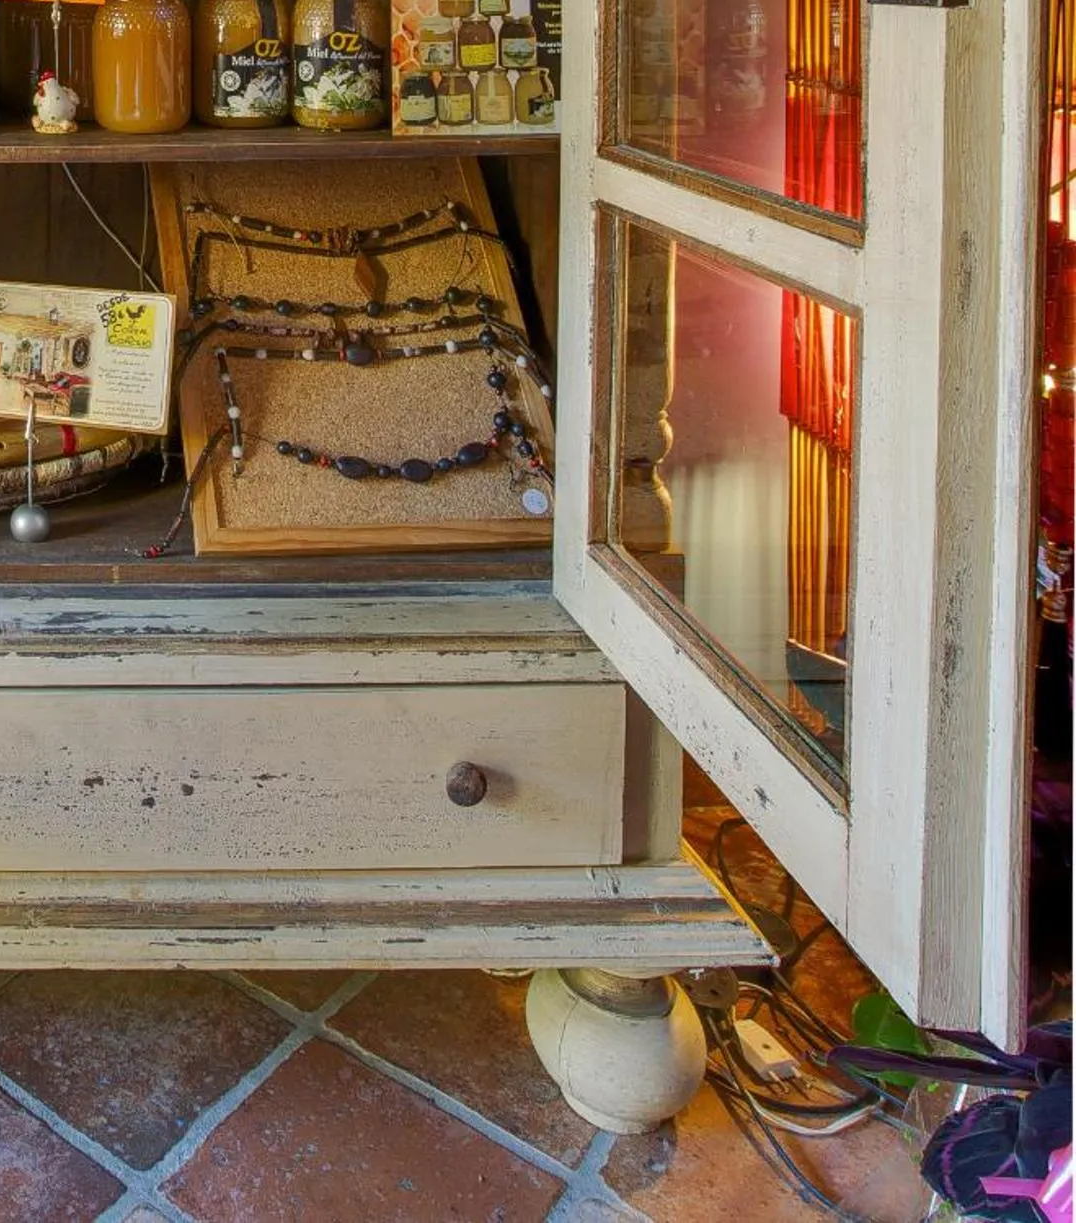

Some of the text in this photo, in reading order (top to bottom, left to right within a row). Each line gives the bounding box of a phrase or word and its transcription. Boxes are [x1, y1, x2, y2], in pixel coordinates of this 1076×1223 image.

[255, 38, 282, 58] OZ
[329, 31, 362, 53] OZ
[232, 56, 255, 66] Miel
[307, 47, 329, 59] Miel
